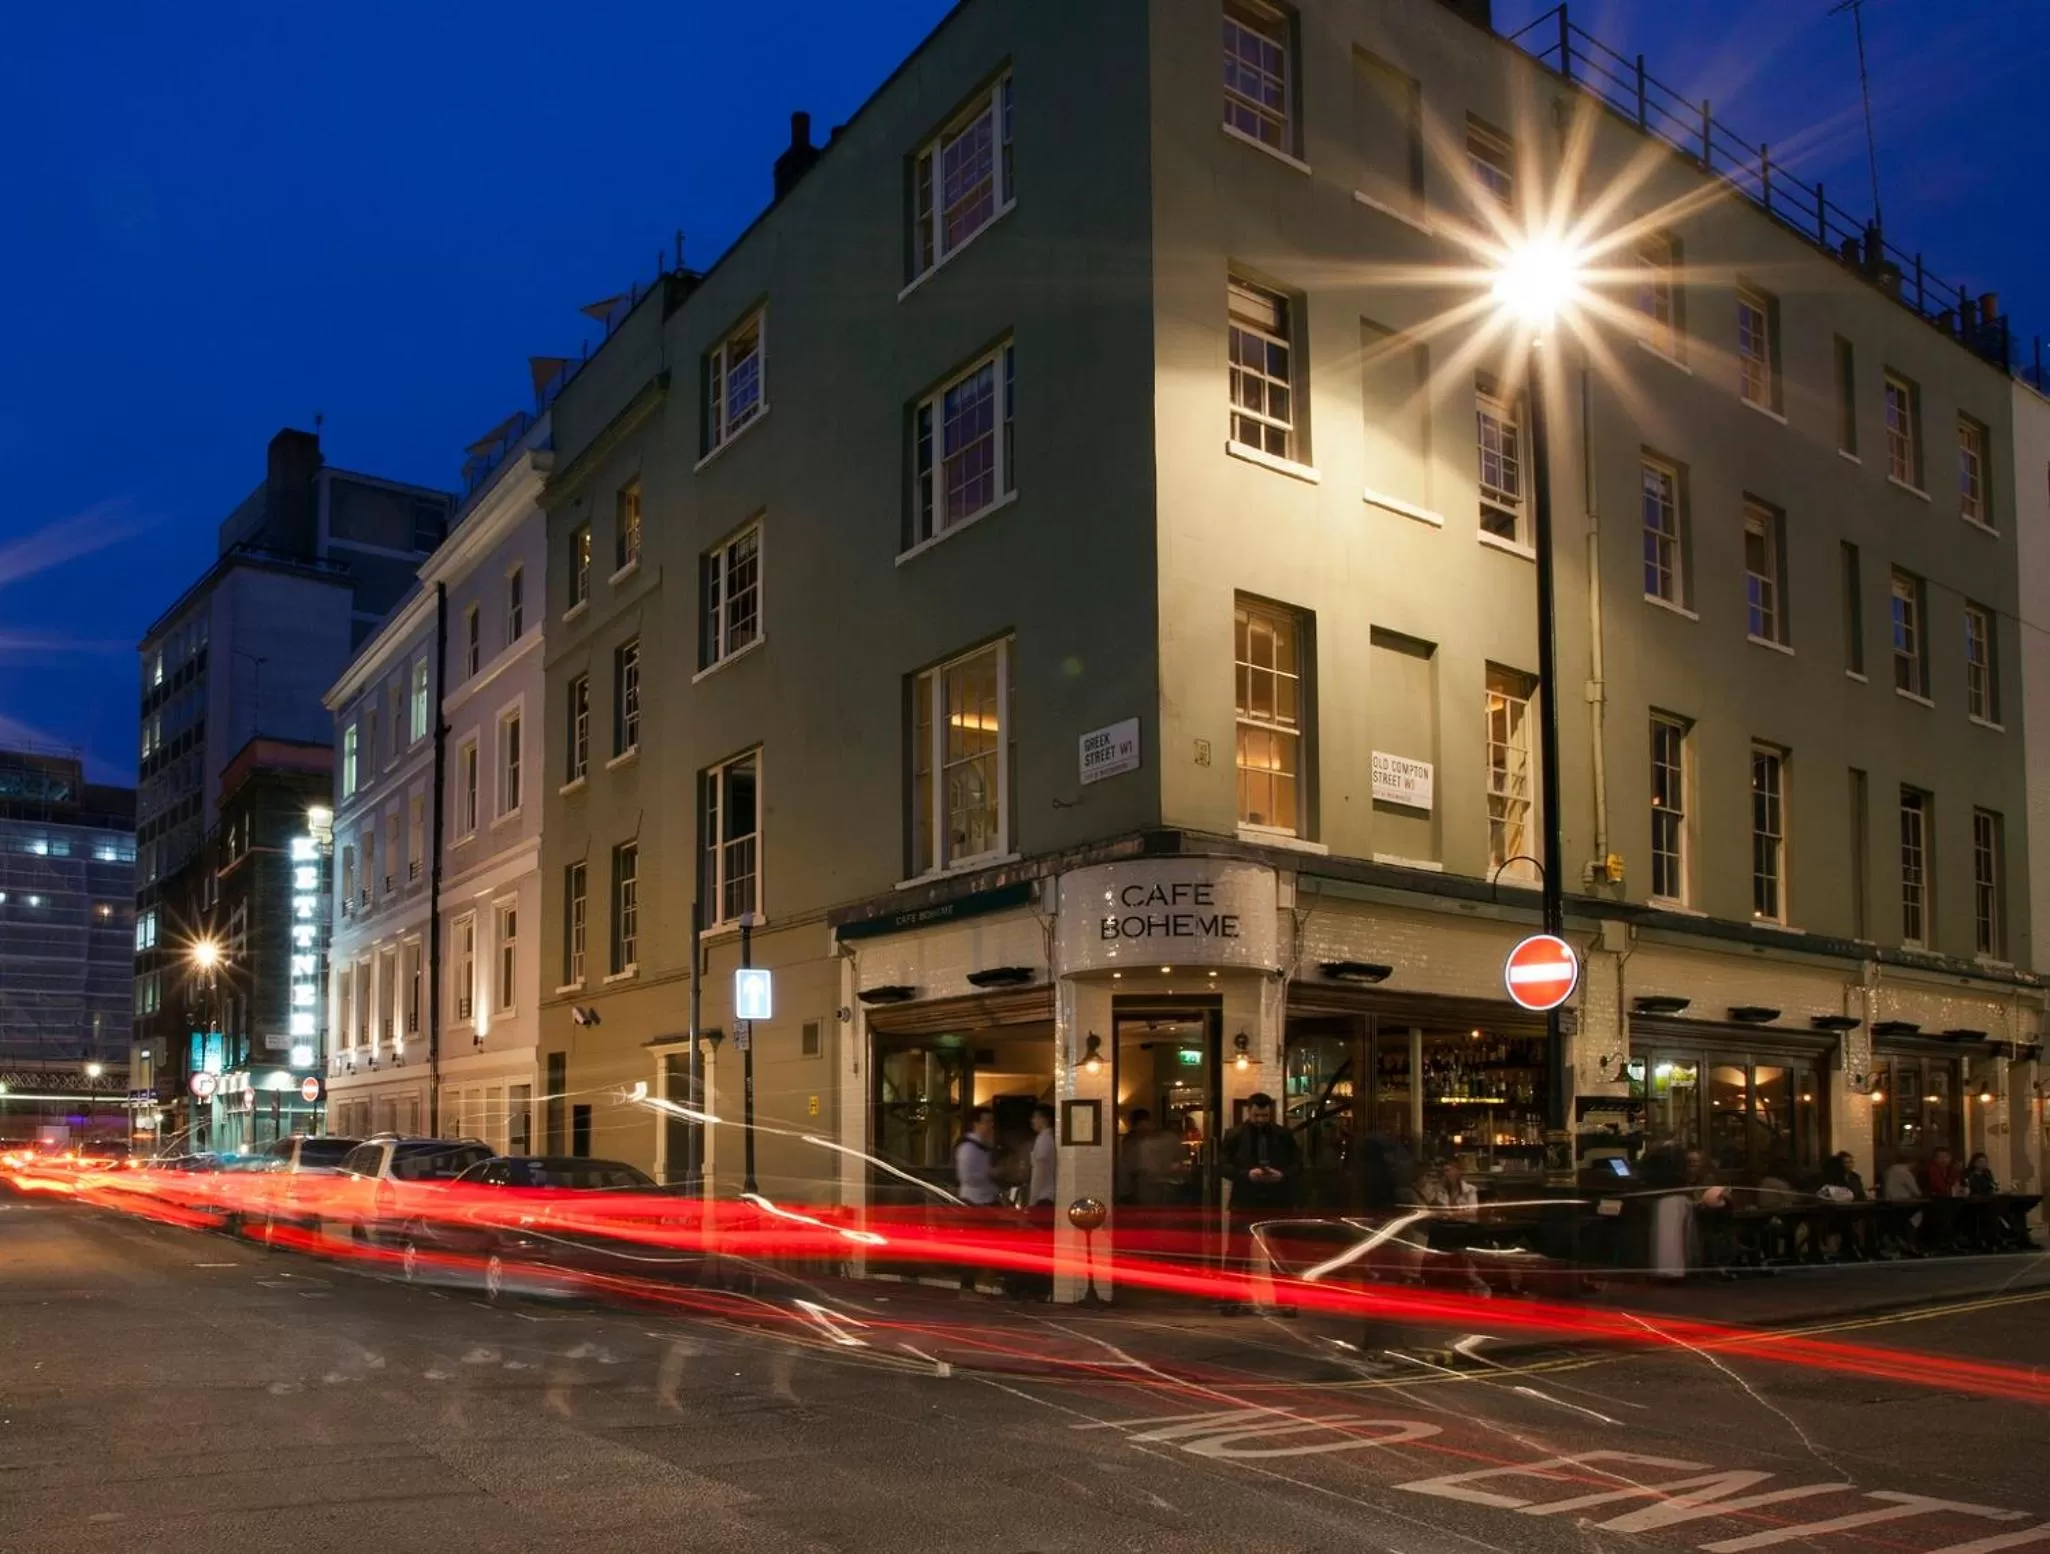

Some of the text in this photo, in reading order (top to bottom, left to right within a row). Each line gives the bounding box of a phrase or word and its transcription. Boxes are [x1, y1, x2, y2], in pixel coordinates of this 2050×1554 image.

[1084, 732, 1110, 751] GREEK
[1084, 740, 1132, 765] STREET W1
[1373, 756, 1429, 780] OLD COMPTON
[1373, 770, 1415, 790] STREET W1
[1121, 883, 1214, 907] CAFE
[1101, 914, 1239, 940] BOHEME
[1069, 1406, 2050, 1554] NO ENT
